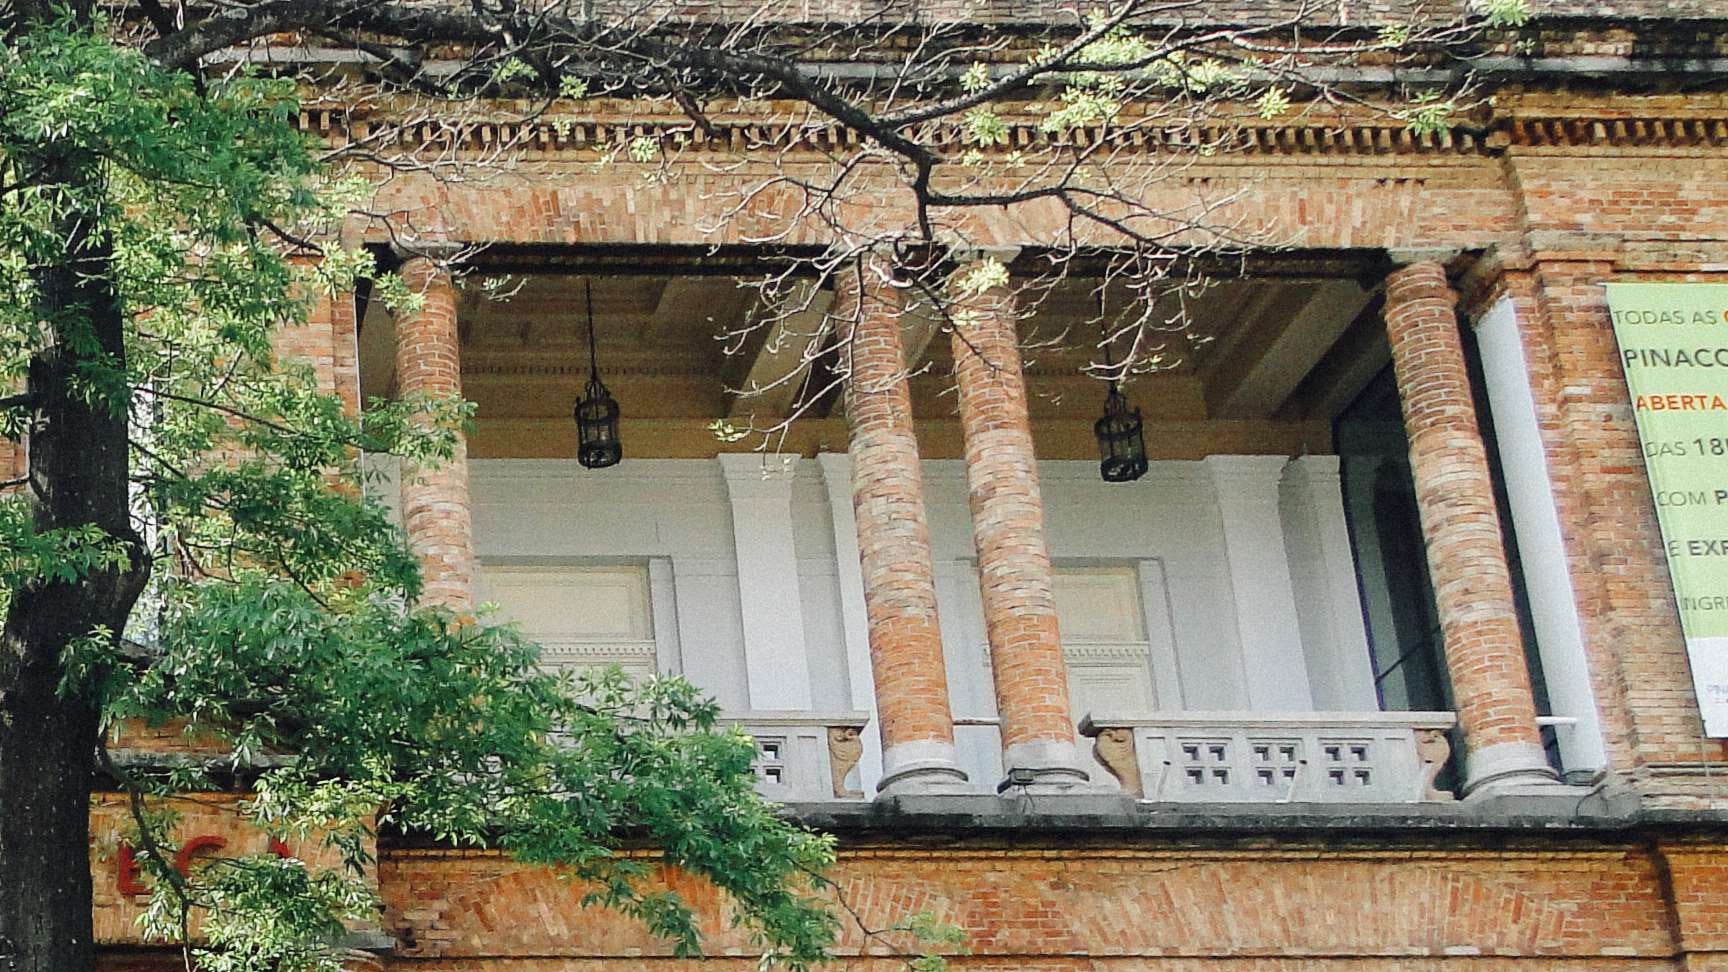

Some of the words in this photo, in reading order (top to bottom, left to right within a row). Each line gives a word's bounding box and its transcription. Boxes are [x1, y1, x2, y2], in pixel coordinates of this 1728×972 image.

[1613, 310, 1684, 325] TODAS
[1692, 310, 1717, 325] AS
[1636, 395, 1728, 411] ABERTA
[1656, 491, 1706, 506] COM
[1668, 540, 1680, 557] E
